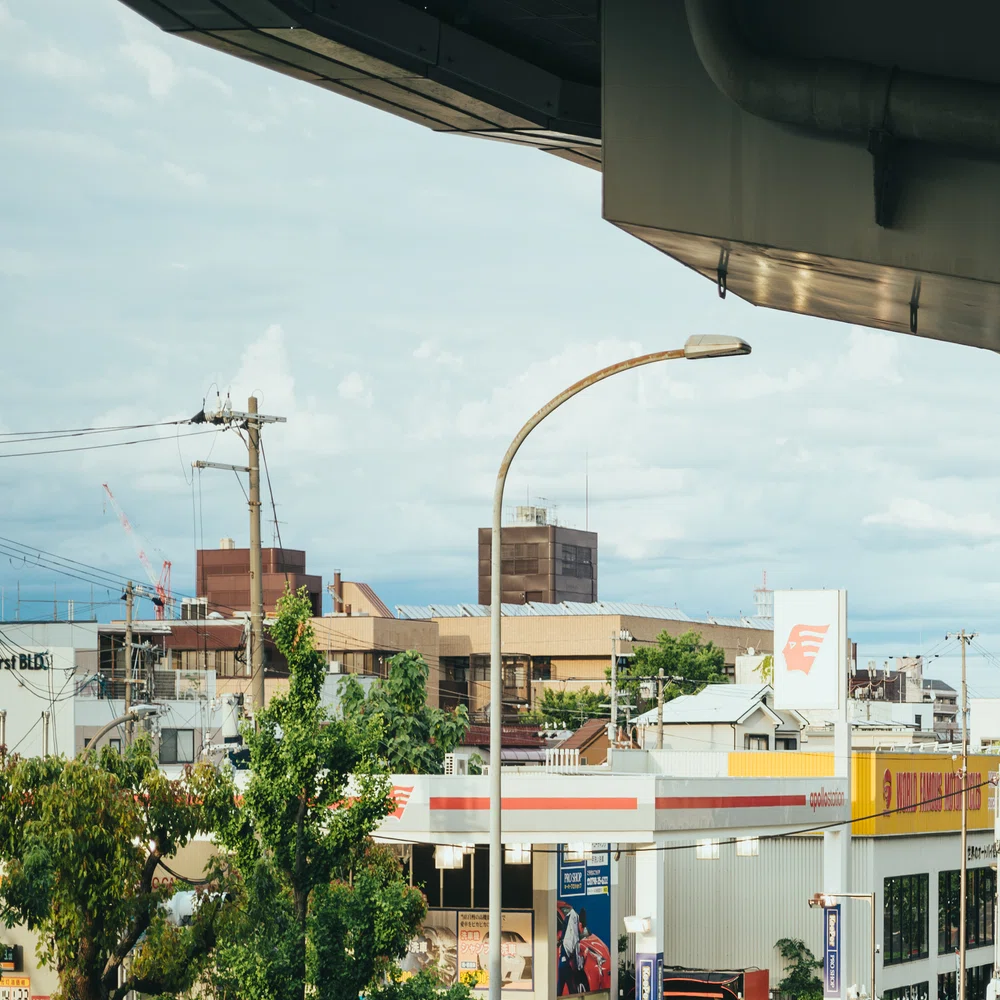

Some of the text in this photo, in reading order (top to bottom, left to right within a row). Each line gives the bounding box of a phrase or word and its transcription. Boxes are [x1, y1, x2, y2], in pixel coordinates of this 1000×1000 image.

[810, 786, 845, 813] apollostation
[896, 772, 918, 813] WORLD
[919, 772, 943, 812] FAMOUS
